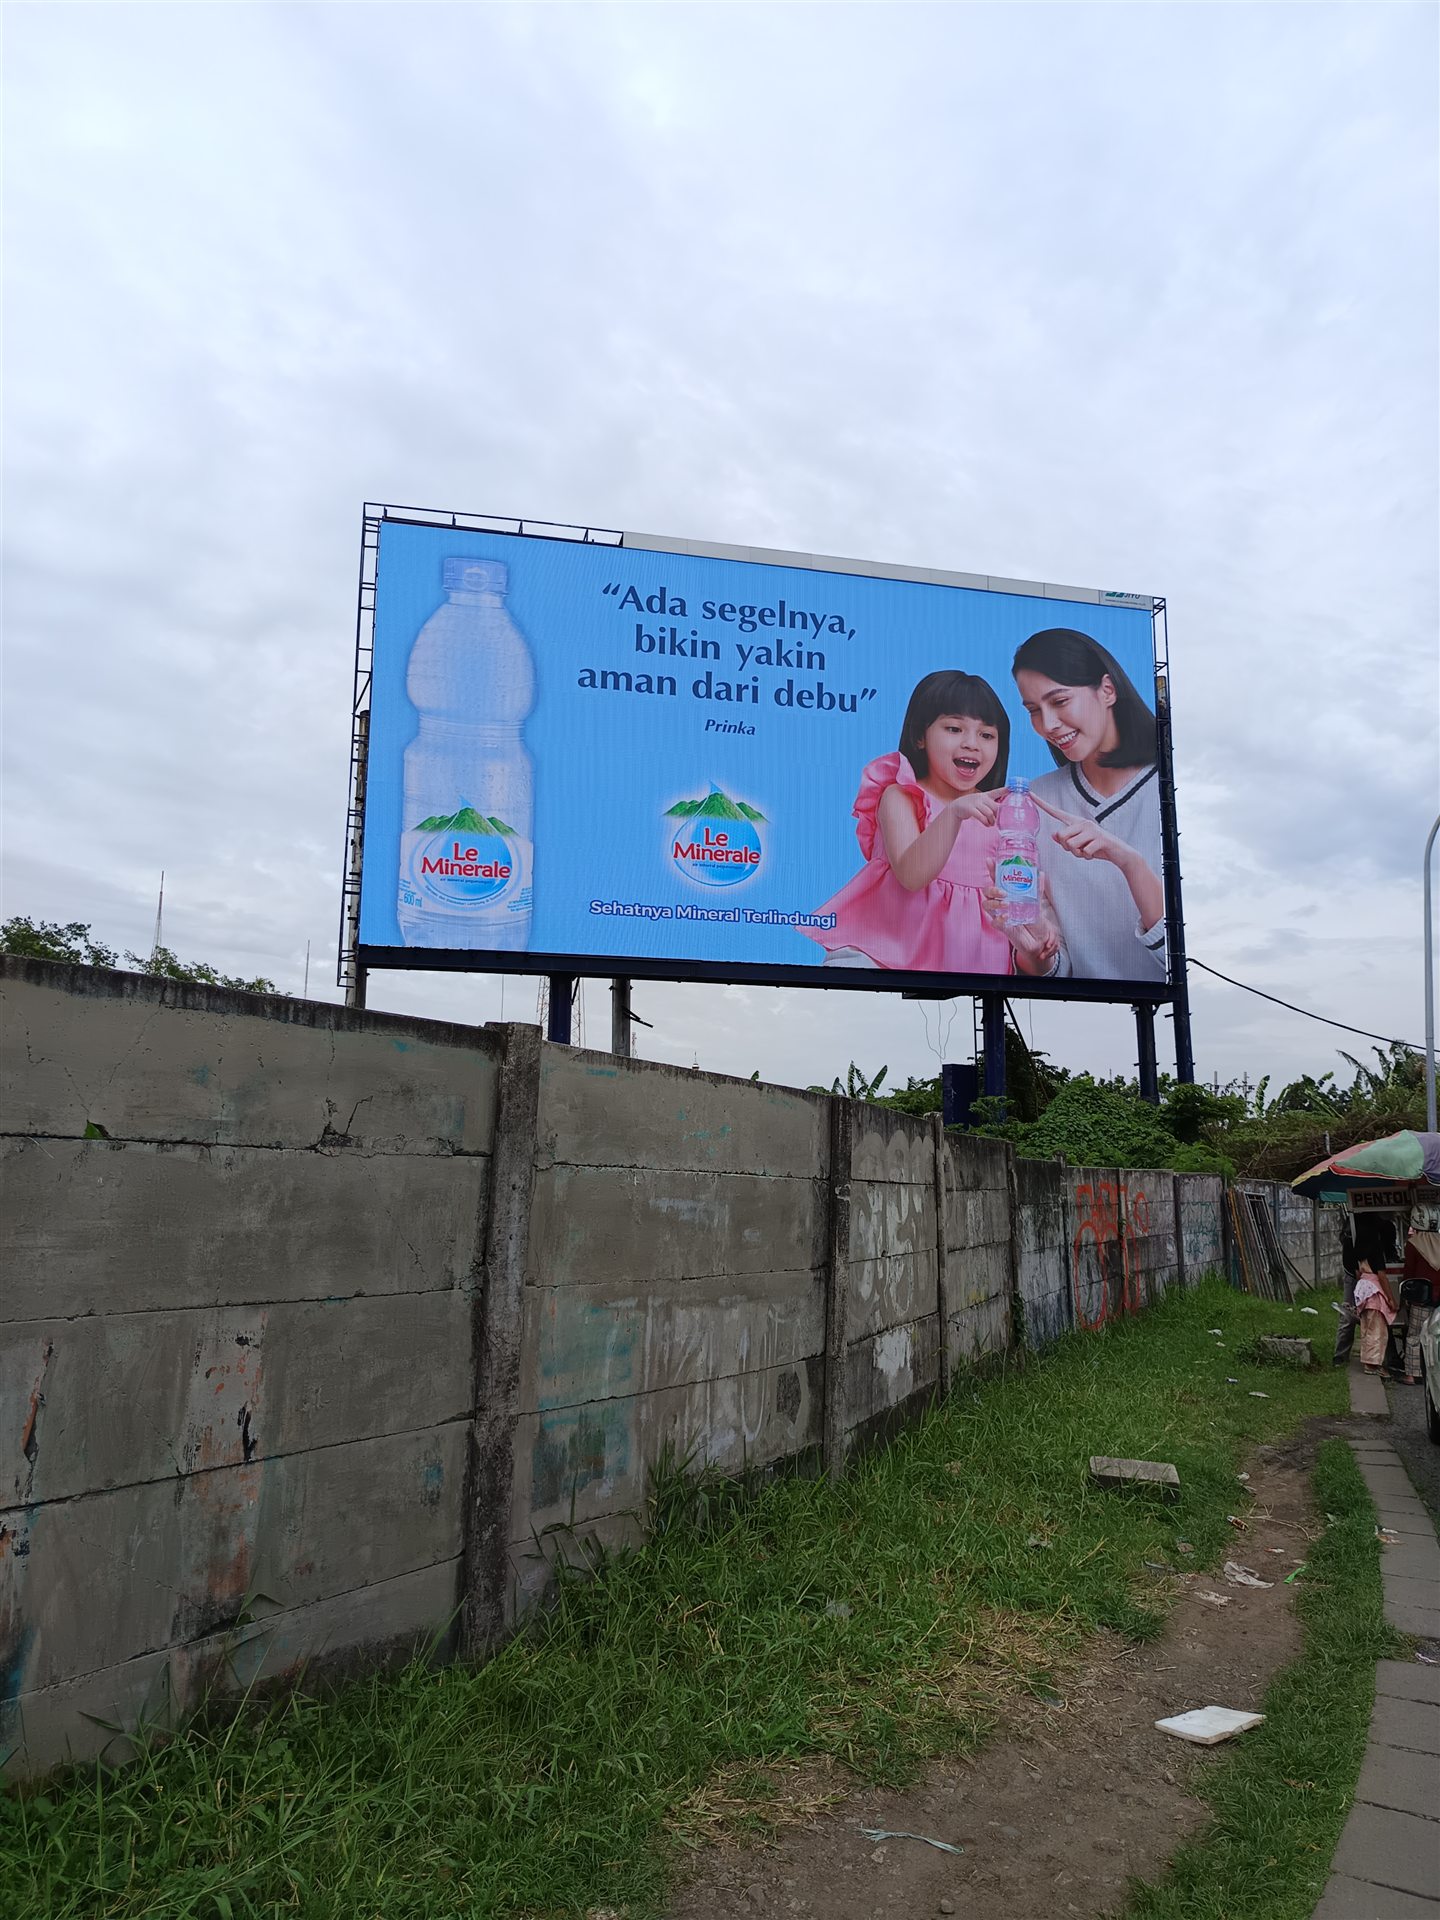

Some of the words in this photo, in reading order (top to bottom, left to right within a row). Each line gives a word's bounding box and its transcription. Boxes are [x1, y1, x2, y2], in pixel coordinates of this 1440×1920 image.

[602, 582, 688, 617] “Ada
[702, 600, 856, 641] segelnya,
[635, 623, 721, 660] bikin
[736, 638, 826, 671] yakin
[577, 667, 677, 696] aman
[692, 671, 759, 704] dari
[774, 679, 877, 713] debu”
[704, 718, 756, 736] Prinka
[704, 827, 728, 847] Le
[453, 842, 478, 862] Le
[673, 841, 760, 864] Minerale
[421, 856, 511, 879] Minerale
[589, 899, 672, 921] Sehatnya
[675, 905, 740, 923] Mineral
[742, 908, 838, 931] Terlindungi
